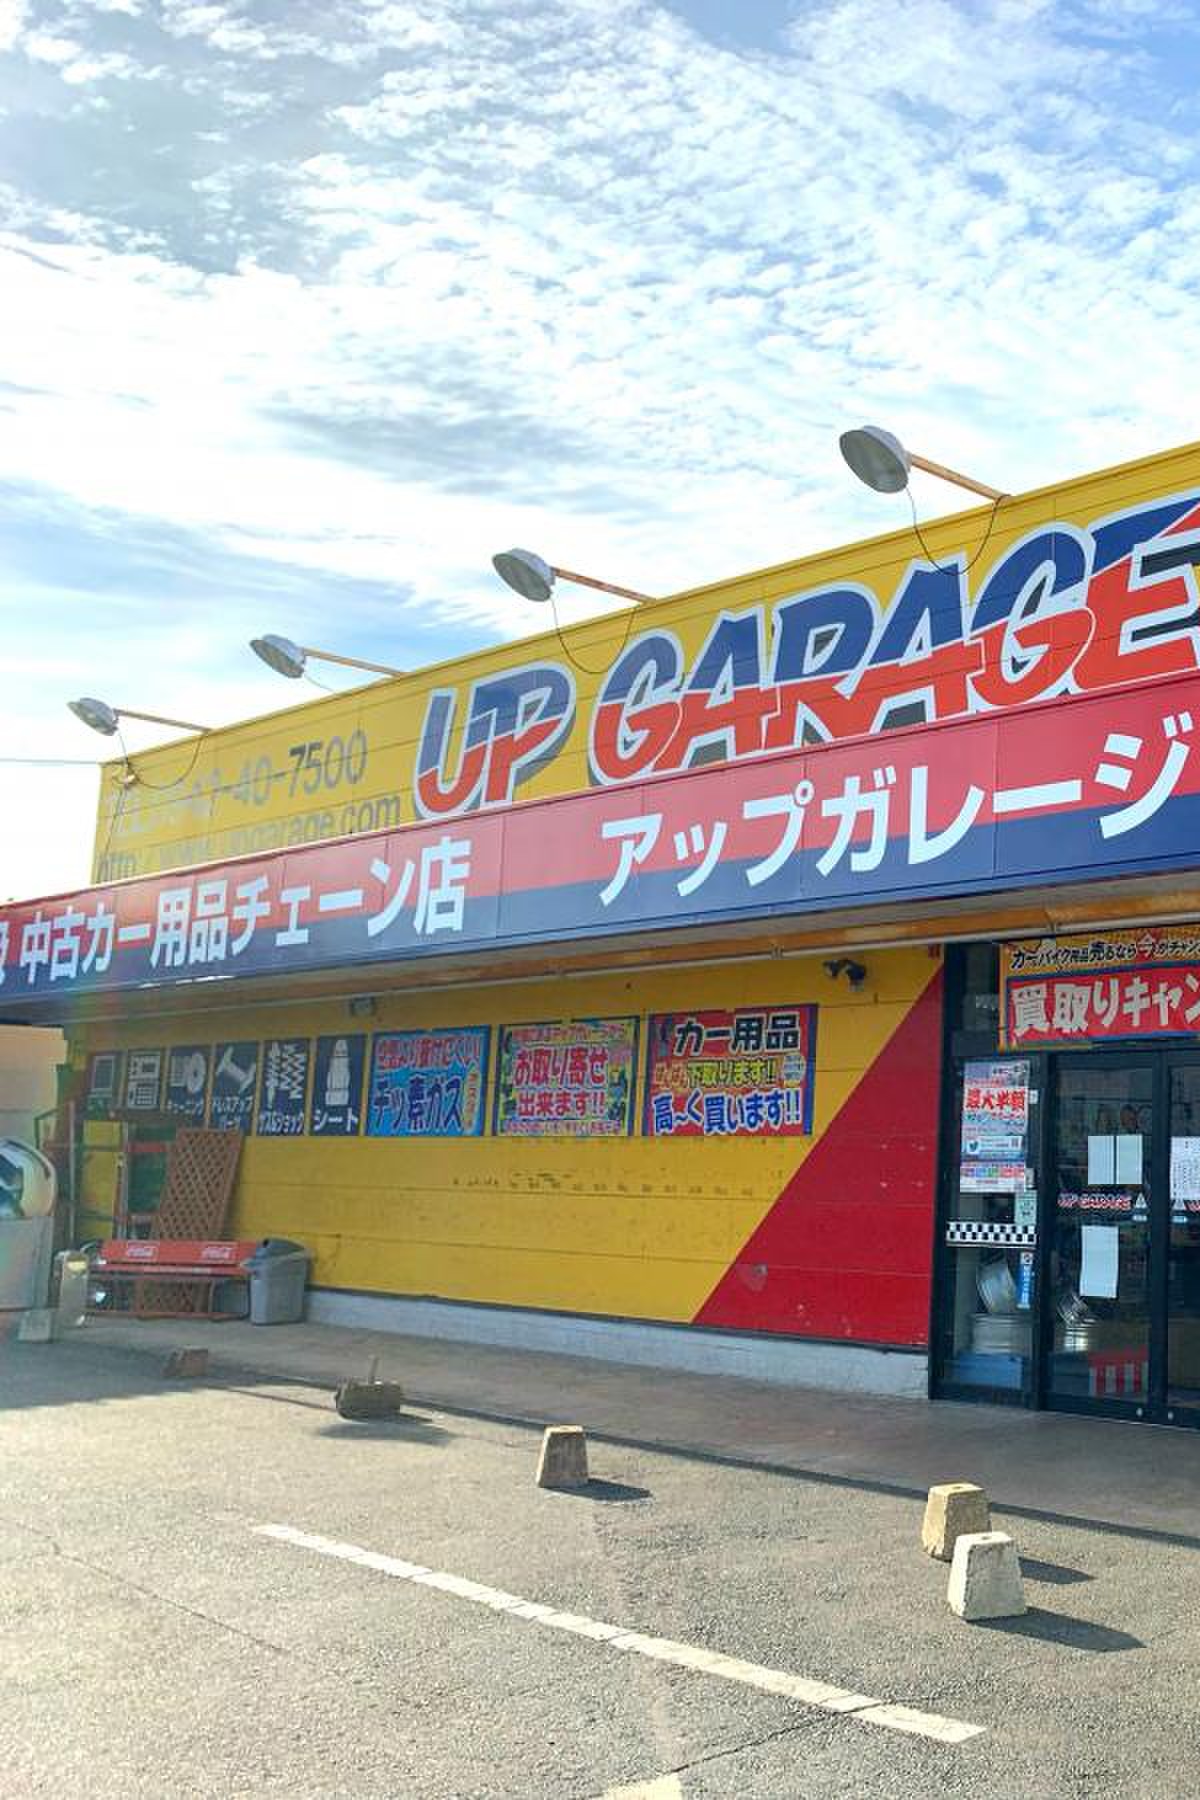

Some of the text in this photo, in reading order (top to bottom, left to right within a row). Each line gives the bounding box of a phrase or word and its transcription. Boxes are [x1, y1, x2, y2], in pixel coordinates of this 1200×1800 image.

[413, 659, 576, 820] UP
[599, 711, 1194, 907] アップガレージ
[20, 835, 472, 985] 中古カー用品チェーン店
[513, 1045, 610, 1087] お取り寄せ
[672, 1011, 801, 1057] カー用品
[313, 1106, 359, 1133] シート
